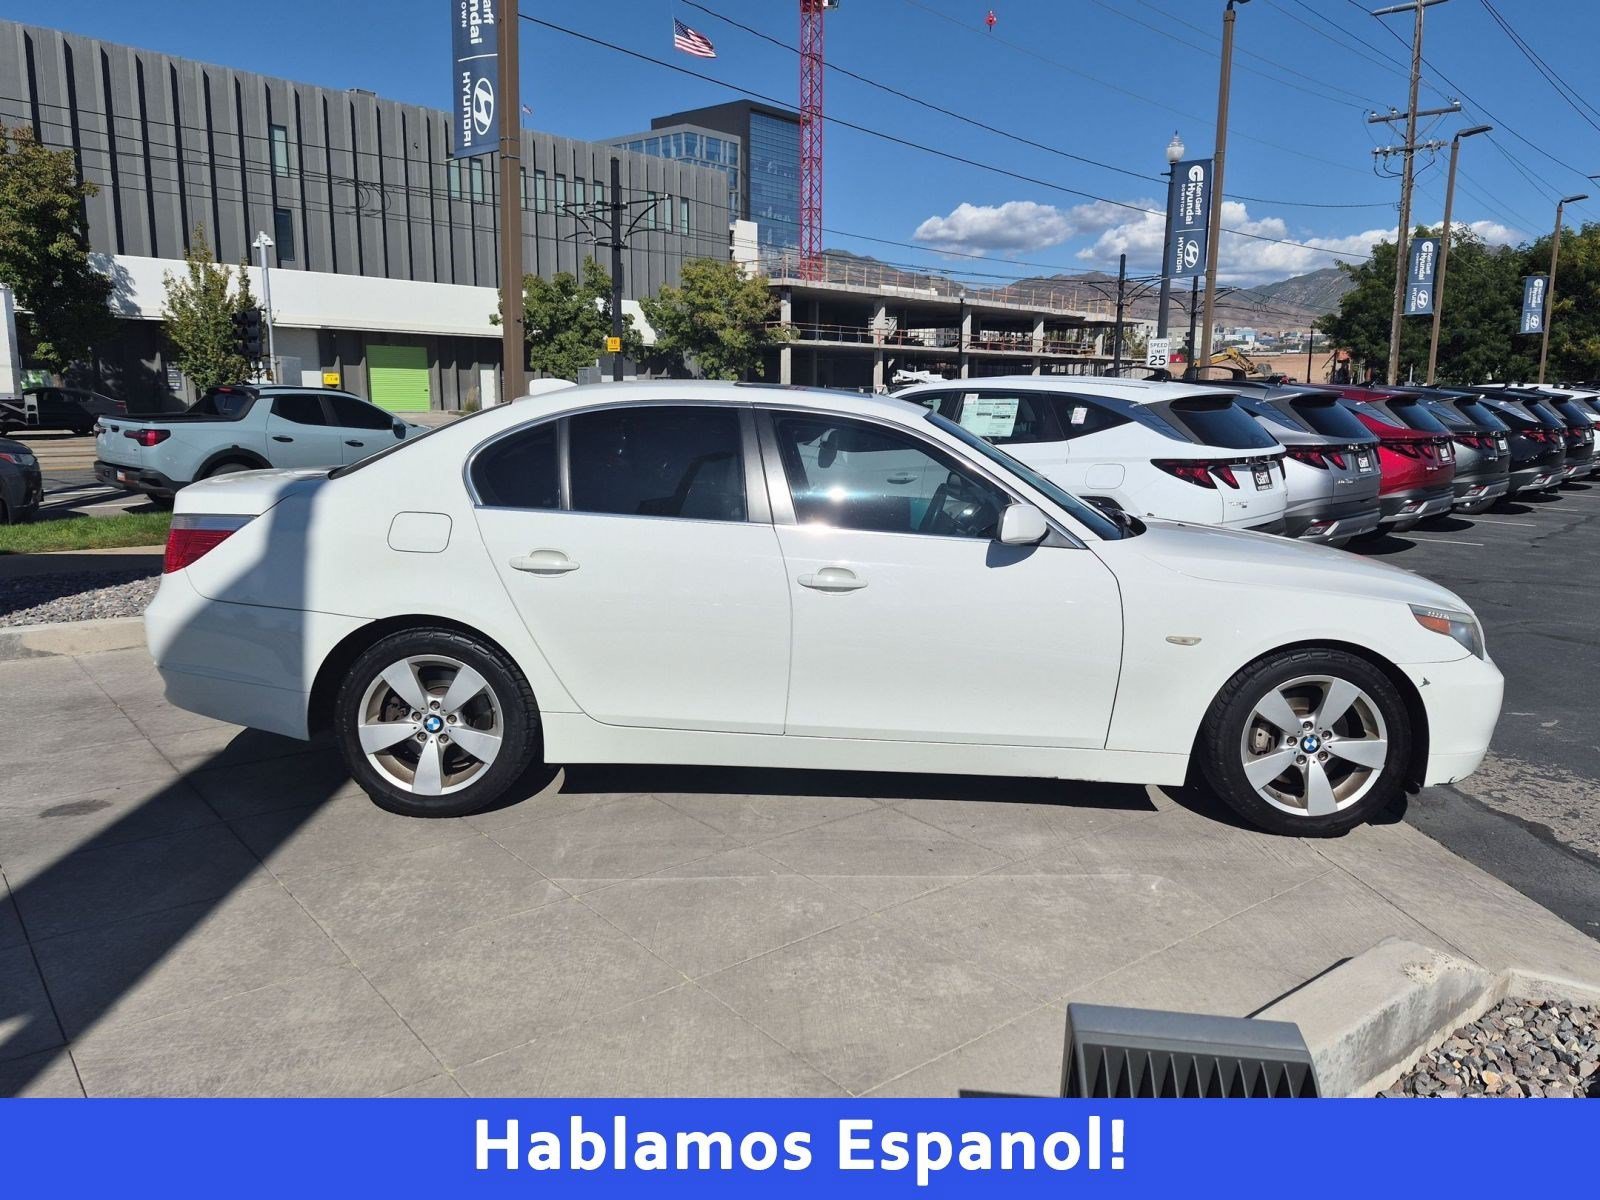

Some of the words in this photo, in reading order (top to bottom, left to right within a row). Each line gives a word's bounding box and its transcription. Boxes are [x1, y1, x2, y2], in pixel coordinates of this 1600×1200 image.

[470, 0, 482, 44] ndai
[483, 0, 494, 24] arff
[463, 71, 471, 147] HYUNDAI
[1185, 183, 1195, 225] Hyundai
[1195, 183, 1203, 197] Ken
[1175, 237, 1184, 274] HYUNDAI
[1149, 355, 1166, 366] 25
